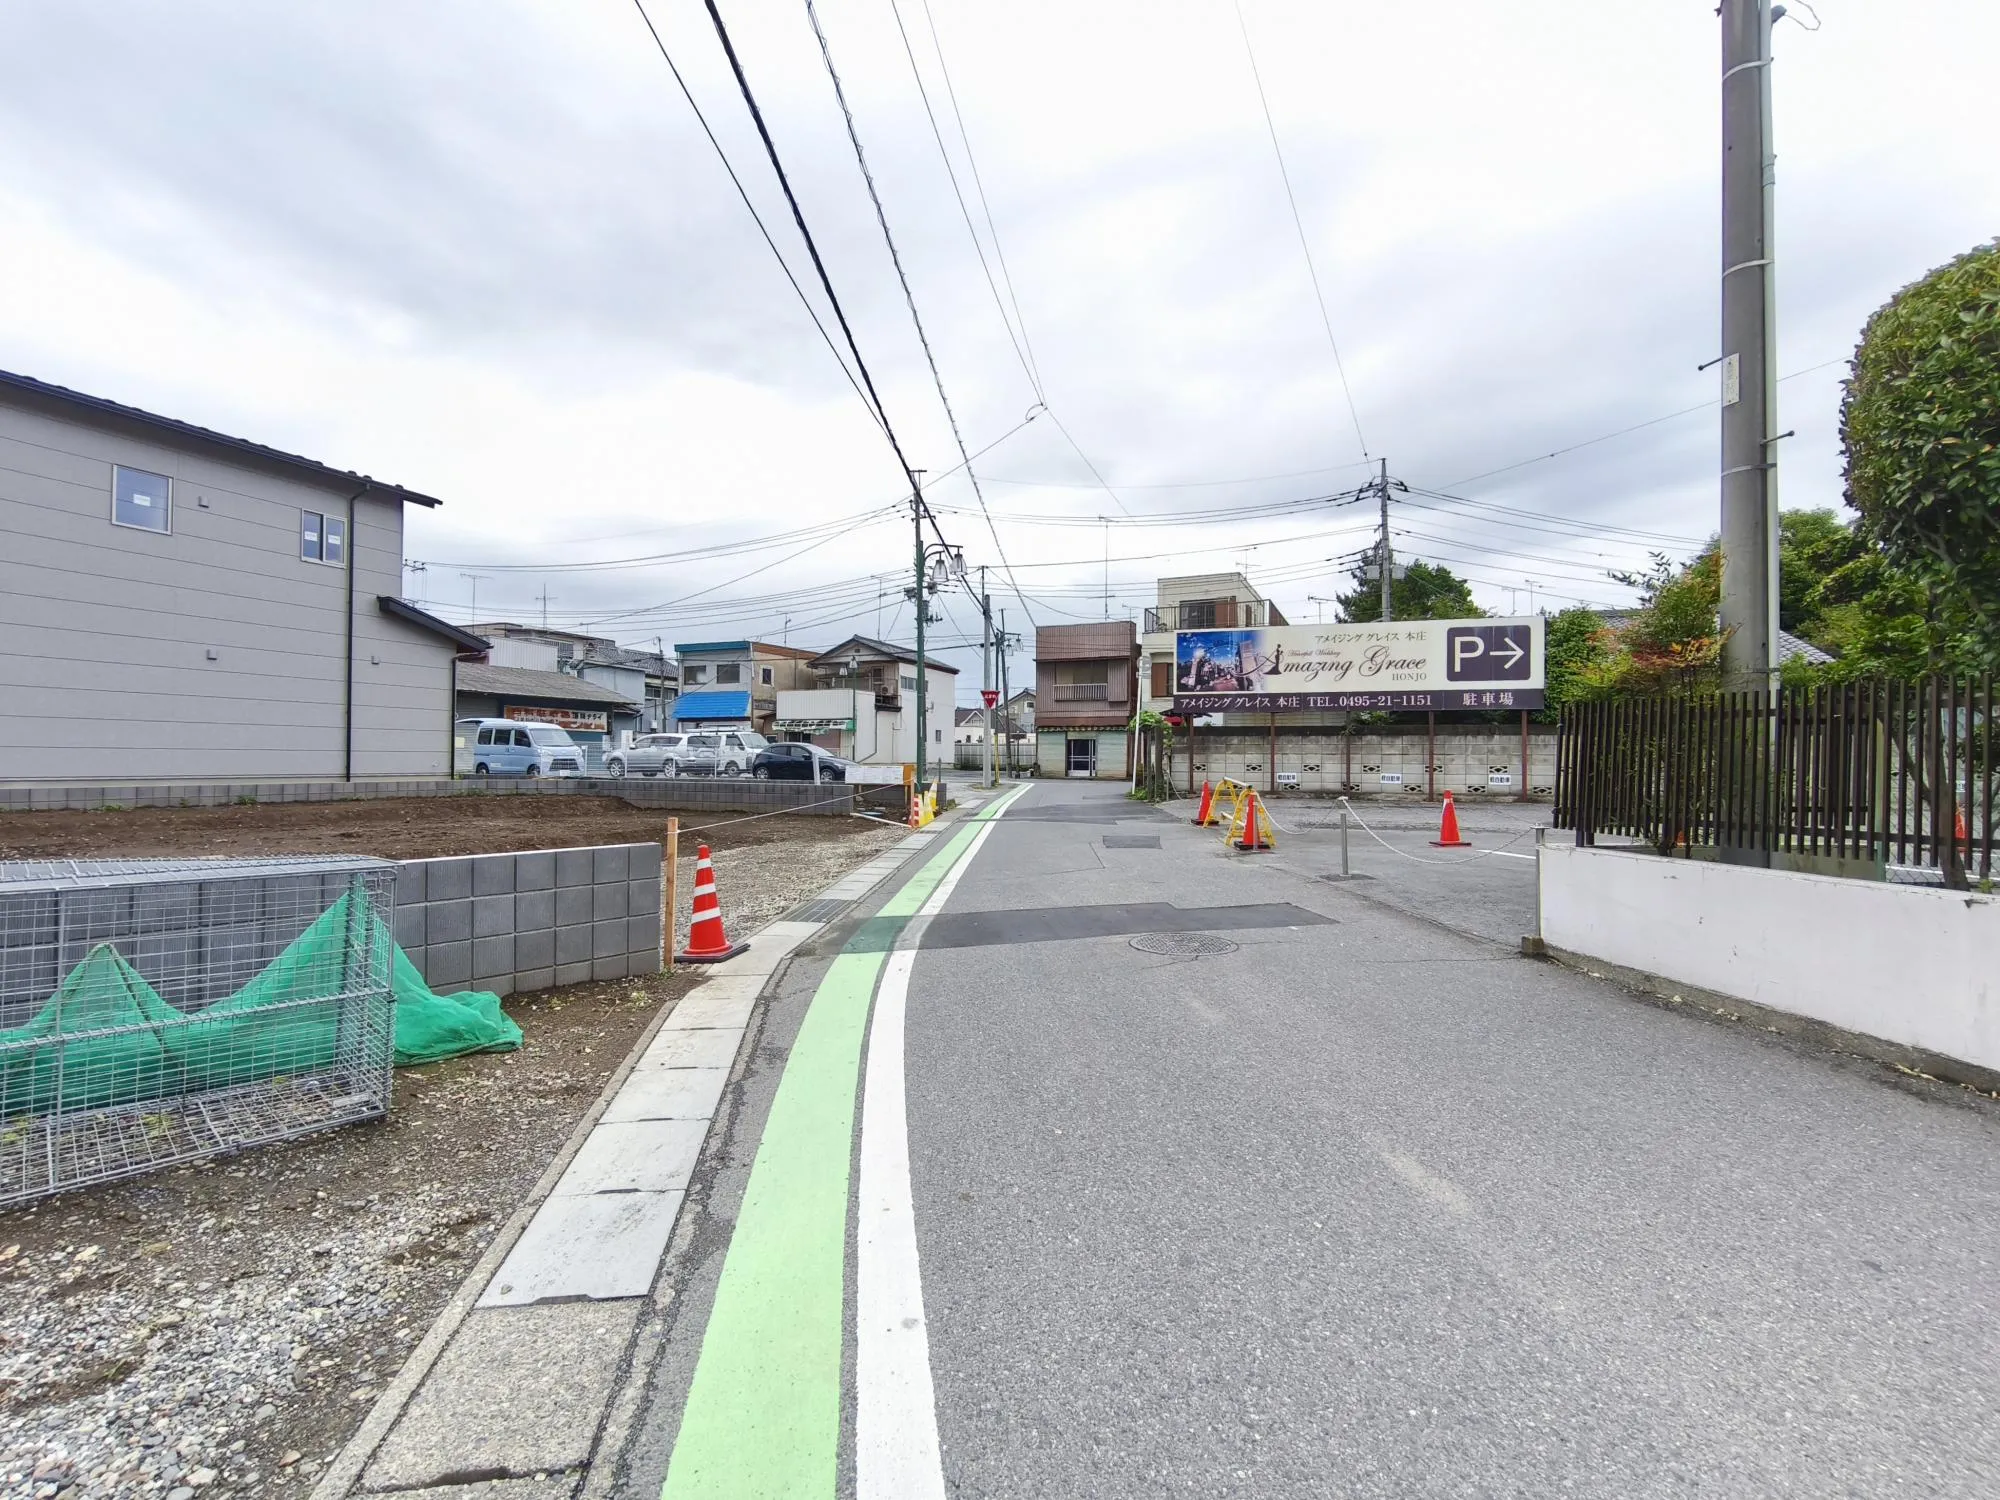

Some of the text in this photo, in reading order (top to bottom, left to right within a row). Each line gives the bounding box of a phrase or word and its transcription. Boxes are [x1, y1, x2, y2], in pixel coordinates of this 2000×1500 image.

[1315, 631, 1427, 644] アメイジング グレイス 本庄
[1454, 636, 1485, 672] P
[1238, 644, 1427, 682] Amazing Grace
[1392, 673, 1427, 681] HONJO
[1180, 695, 1300, 709] アメイジング グレイス 本庄
[1462, 692, 1514, 706] 駐車場
